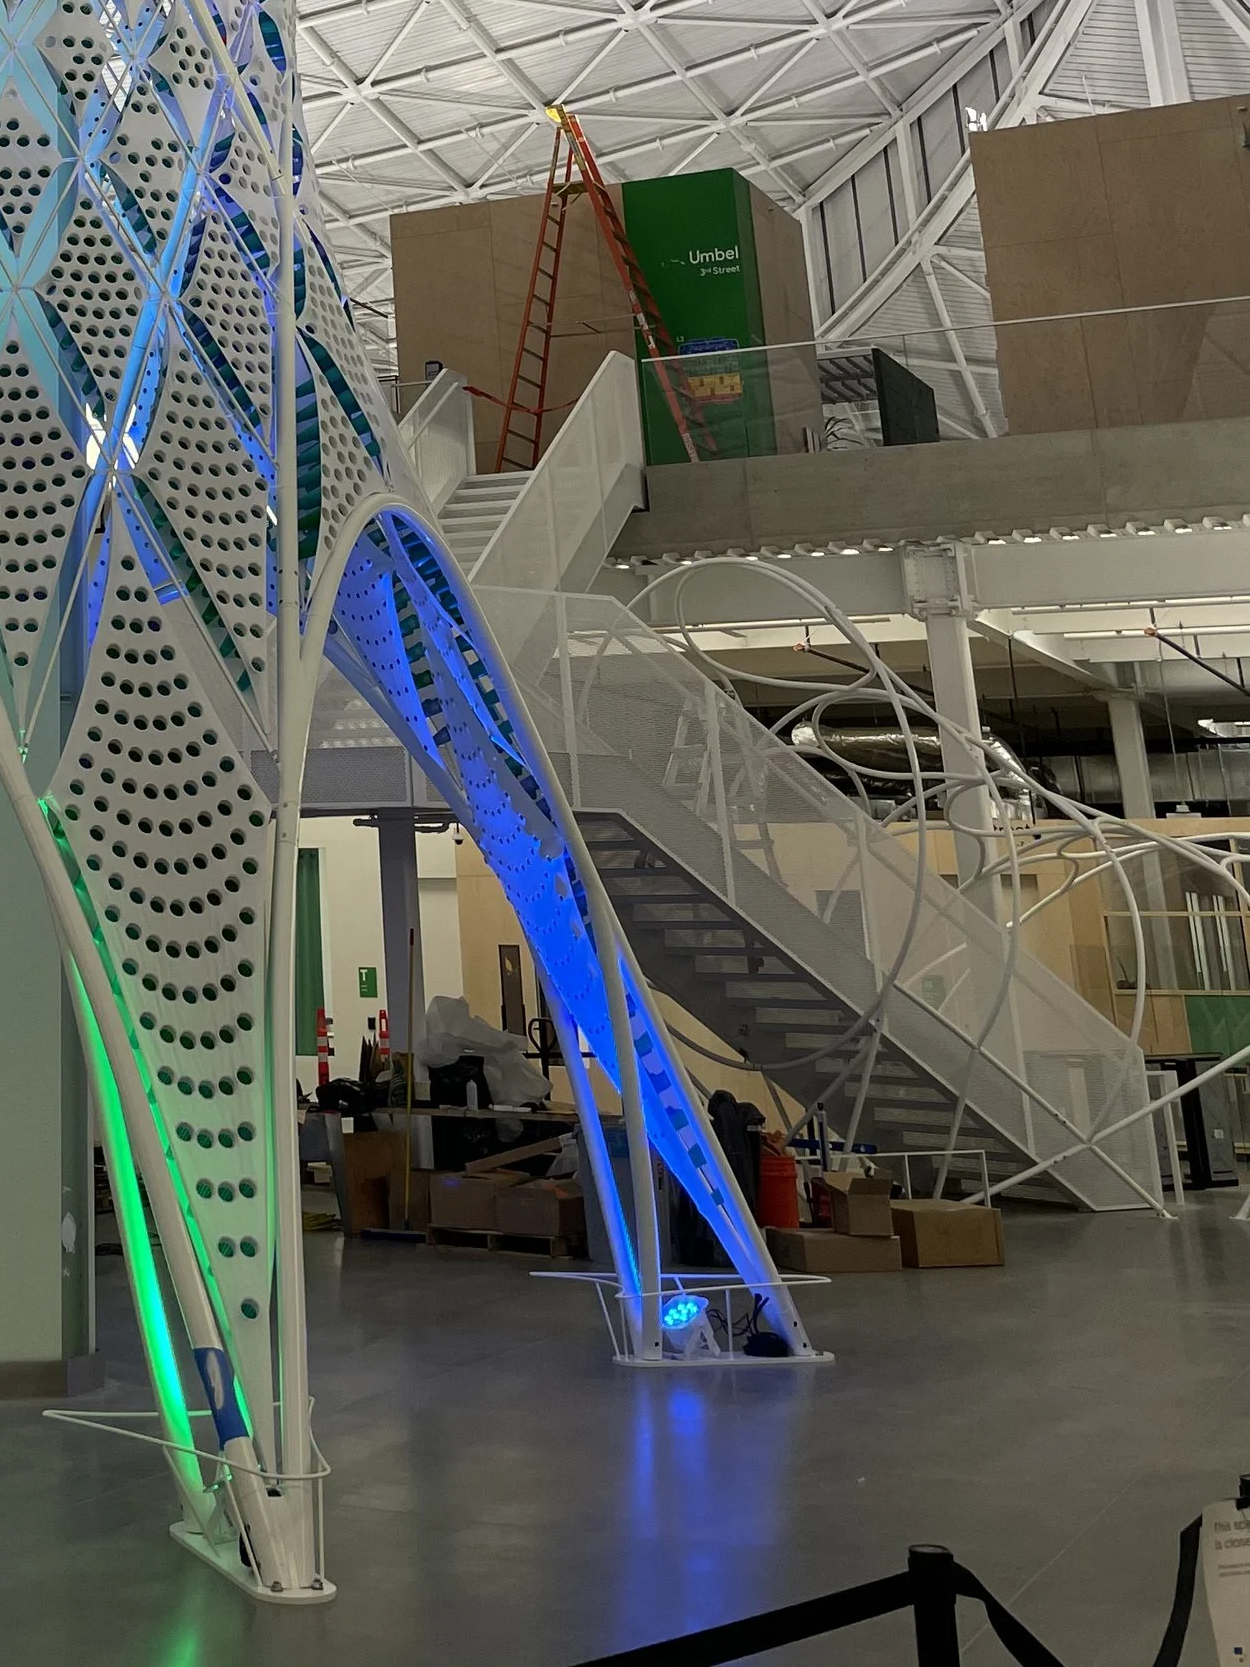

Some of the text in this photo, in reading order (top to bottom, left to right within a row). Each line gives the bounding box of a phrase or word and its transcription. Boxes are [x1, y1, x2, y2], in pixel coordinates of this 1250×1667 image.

[689, 245, 739, 264] Umbel
[699, 264, 741, 277] 3rd Street
